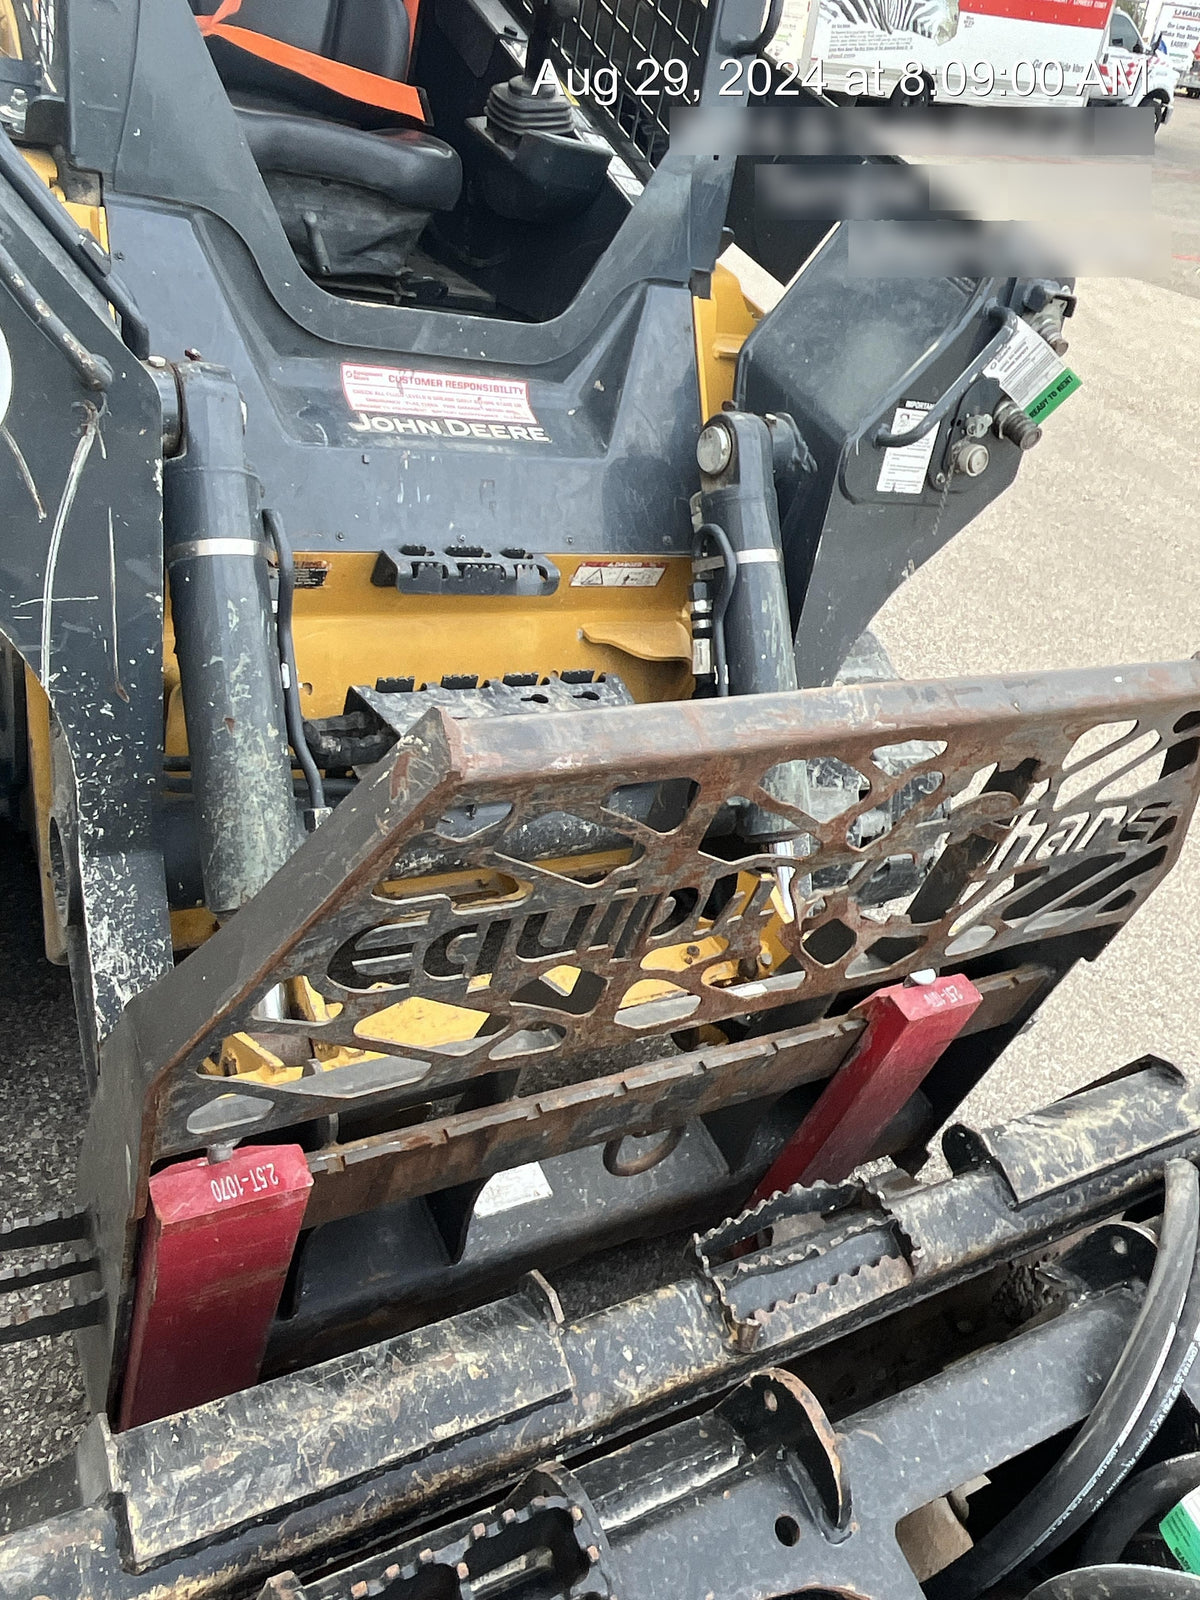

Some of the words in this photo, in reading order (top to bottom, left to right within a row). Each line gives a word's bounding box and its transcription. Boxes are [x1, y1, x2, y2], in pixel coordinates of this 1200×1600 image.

[388, 374, 443, 388] CUSTOMER
[445, 380, 524, 395] RESPONSIBILITY
[1028, 398, 1049, 418] READY
[1047, 390, 1058, 400] TO
[1056, 374, 1074, 392] RENT
[348, 412, 442, 435] JOHN
[445, 419, 551, 443] DEERE
[210, 1163, 280, 1203] 2.5T-1070
